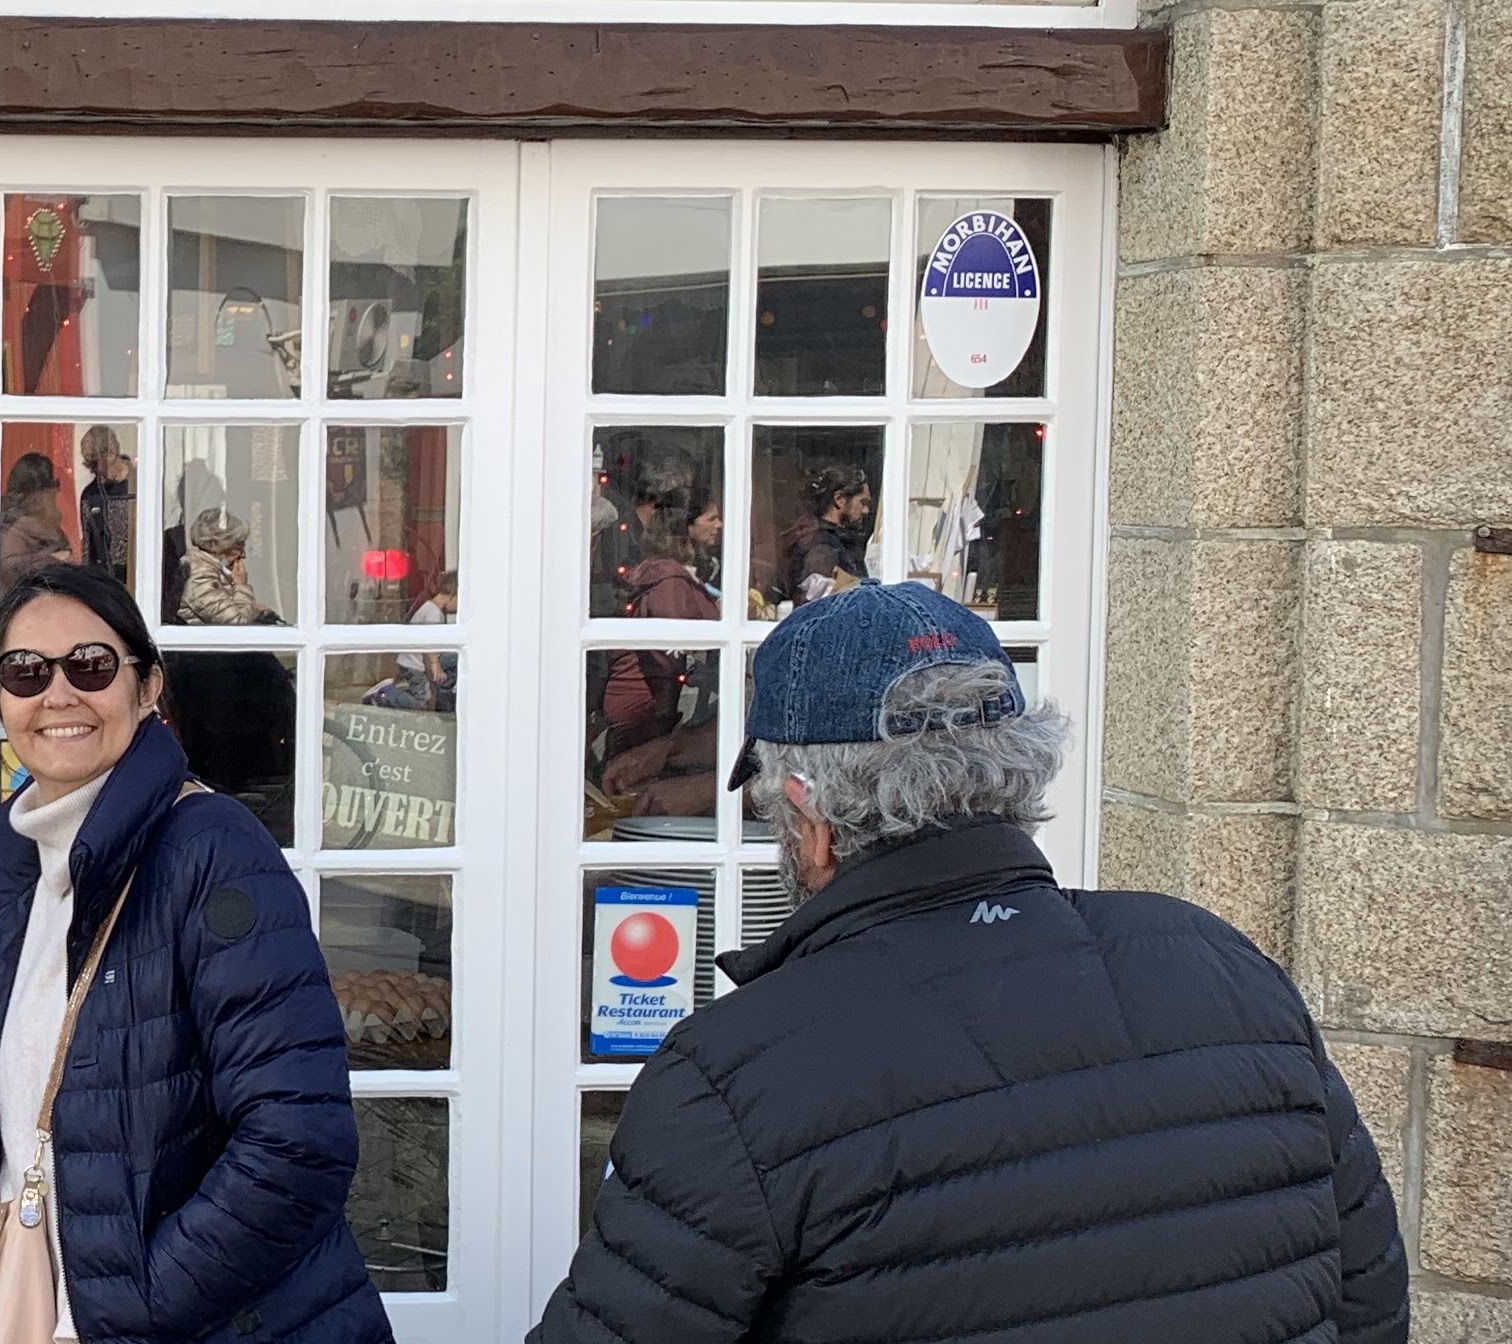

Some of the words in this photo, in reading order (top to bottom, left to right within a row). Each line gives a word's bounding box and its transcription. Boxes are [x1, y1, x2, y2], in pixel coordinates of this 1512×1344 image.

[932, 214, 1033, 275] MORBIHAN
[952, 271, 1011, 290] LICENCE
[970, 353, 987, 364] 654
[345, 713, 447, 755] Entrez
[361, 757, 413, 783] c'est
[322, 781, 456, 843] OUVERT
[620, 891, 667, 902] Bienvenue
[618, 992, 667, 1006] Ticket
[596, 1005, 687, 1018] Restaurant
